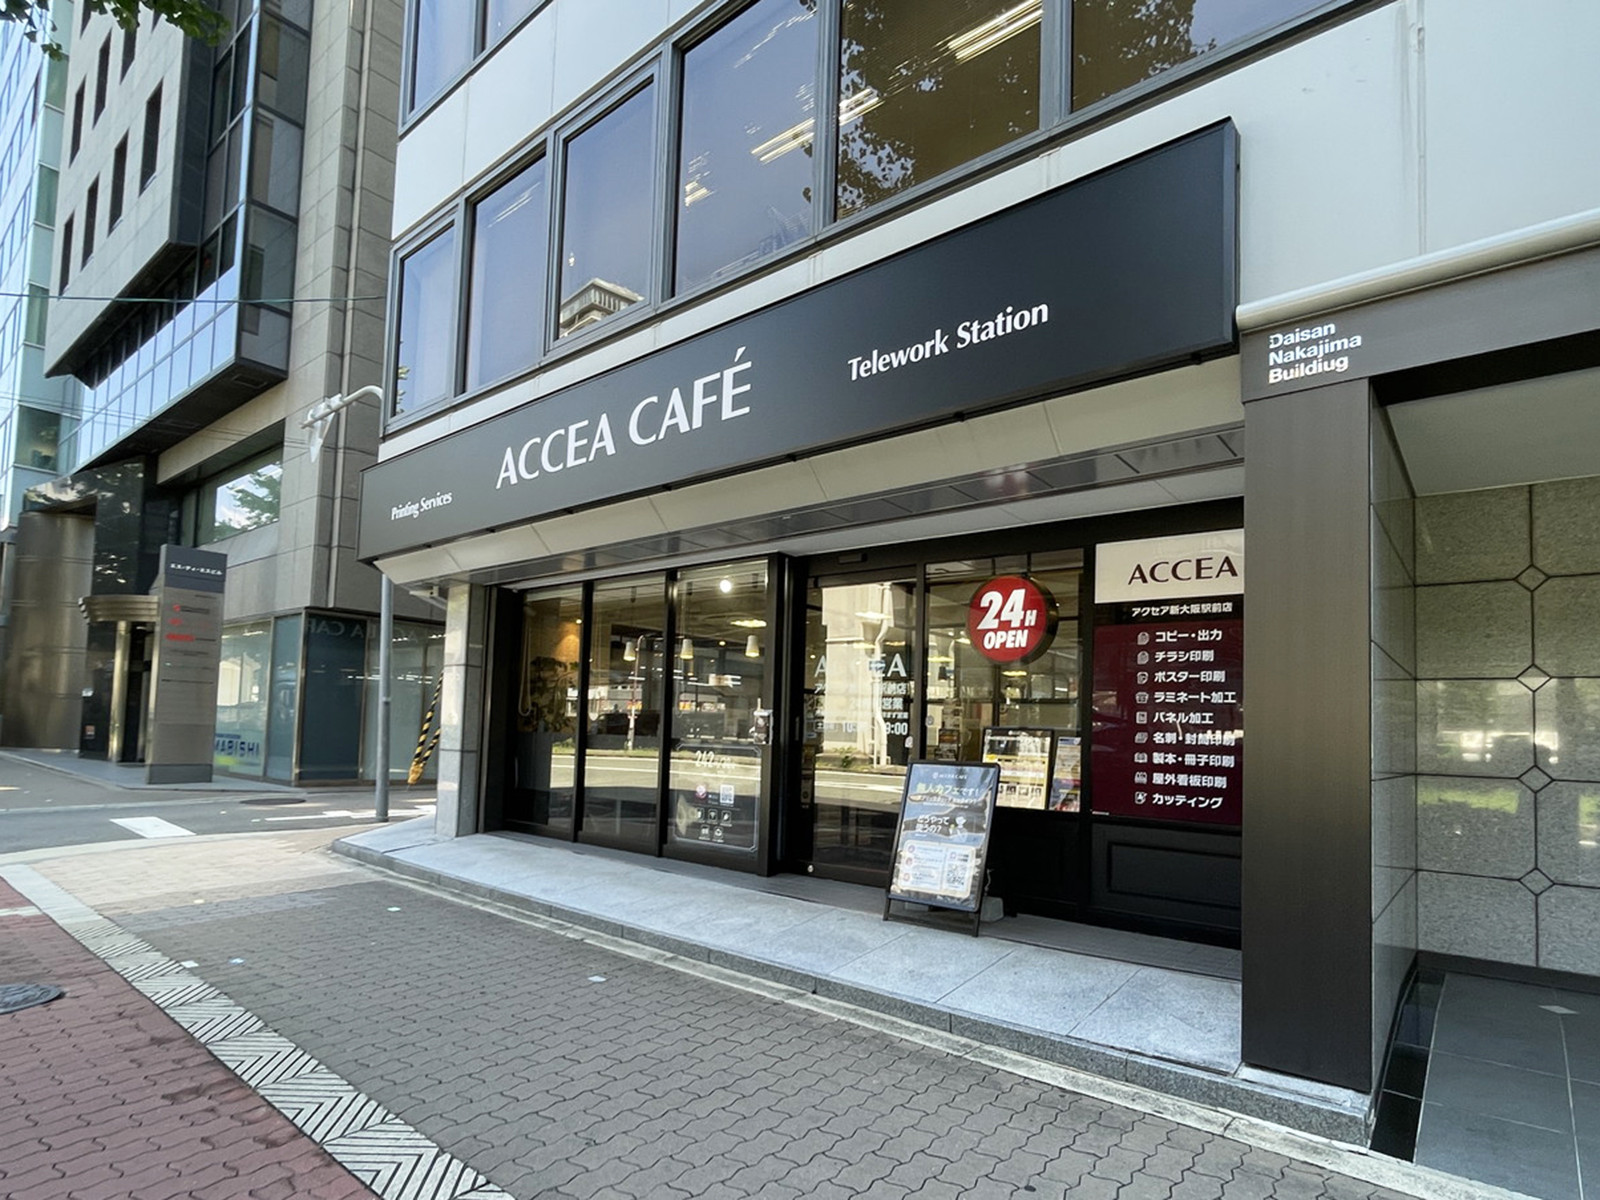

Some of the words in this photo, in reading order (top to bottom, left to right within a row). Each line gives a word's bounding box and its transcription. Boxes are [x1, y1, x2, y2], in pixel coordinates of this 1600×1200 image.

[847, 328, 950, 381] Telework
[956, 303, 1049, 349] Station
[1268, 323, 1336, 349] Daisan
[1268, 335, 1362, 366] Nakajima
[495, 412, 616, 489] ACCEA
[628, 346, 752, 445] CAFÉ
[391, 501, 420, 520] Printing
[420, 491, 452, 512] Services
[1128, 556, 1238, 586] ACCEA
[1131, 602, 1233, 618] アクセア新大阪駅前店
[983, 629, 1029, 650] OPEN
[1155, 629, 1223, 643] コピー・出力
[1154, 650, 1214, 663] チラシ印刷
[1154, 670, 1226, 683] ポスター印刷
[1153, 691, 1237, 704] ラミネート加工
[1152, 712, 1214, 725] パネル加工
[1152, 752, 1236, 768] 製本・冊子印刷
[1152, 772, 1228, 789] 屋外看板印刷
[1152, 793, 1224, 809] カッティング
